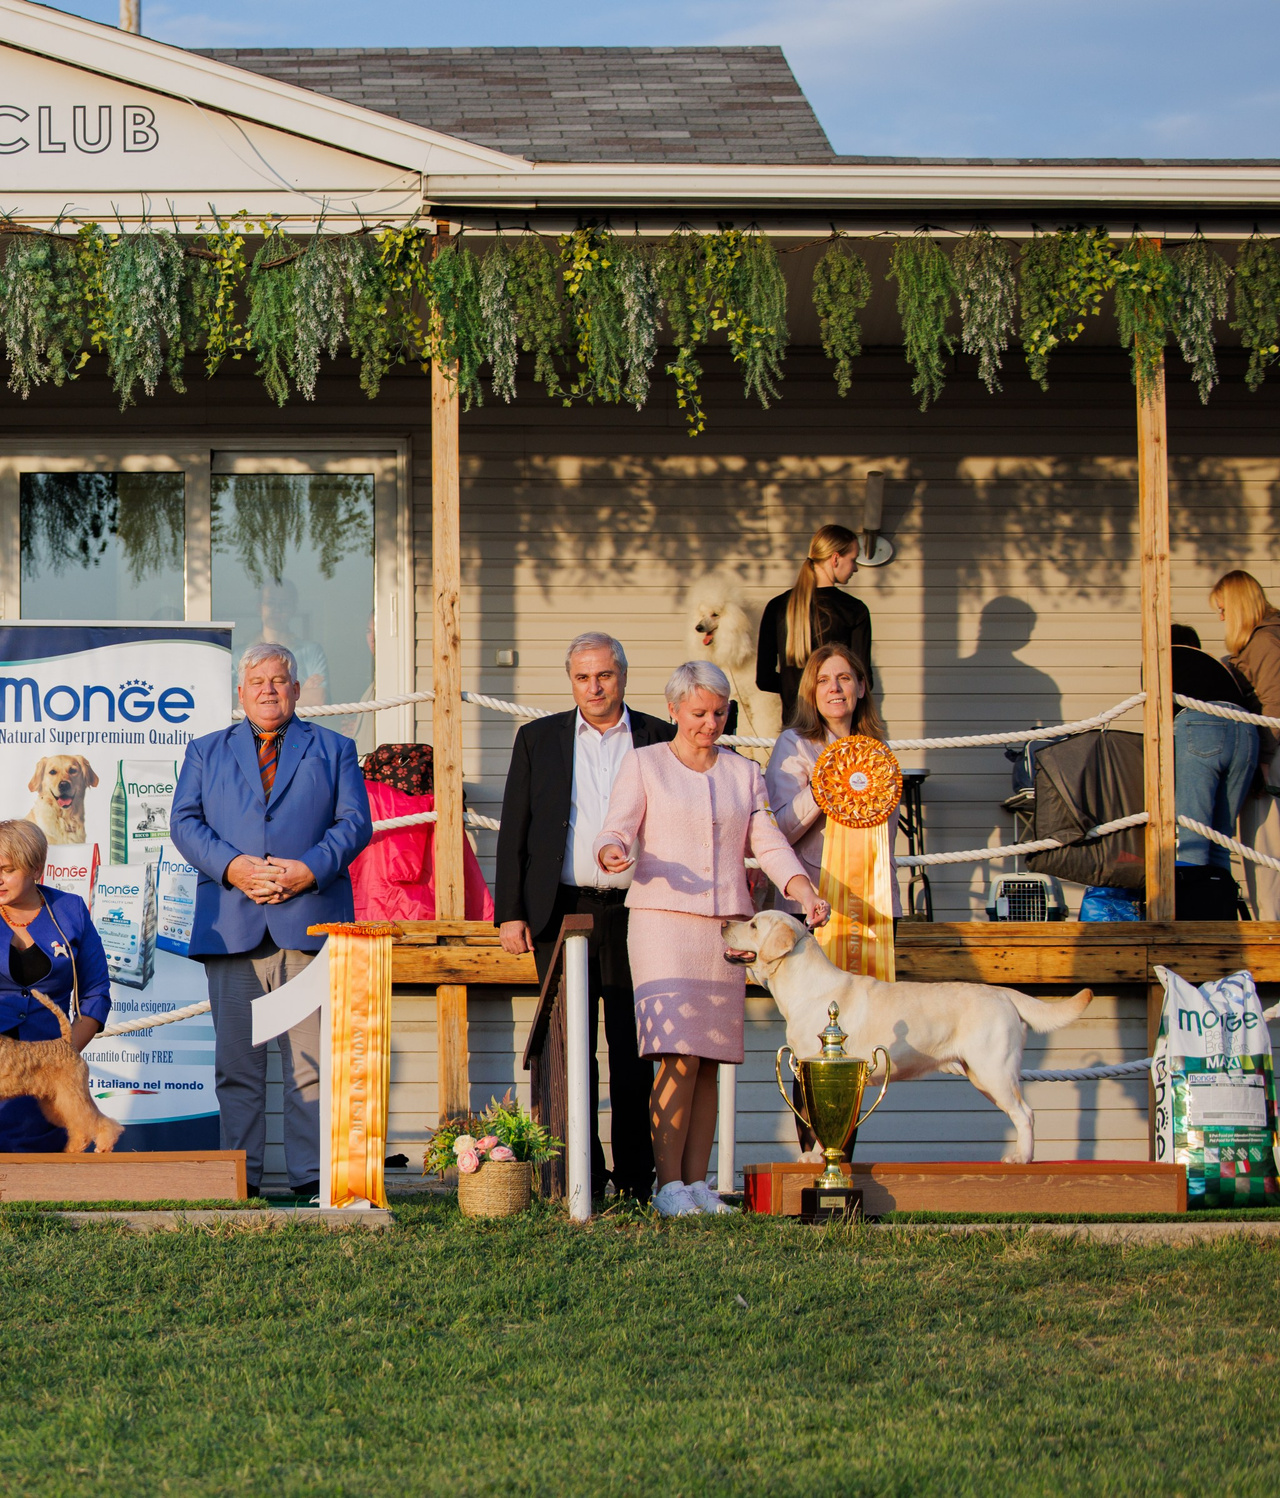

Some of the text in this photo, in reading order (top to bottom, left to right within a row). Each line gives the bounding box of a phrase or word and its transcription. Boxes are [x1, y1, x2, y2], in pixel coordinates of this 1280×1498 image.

[49, 728, 145, 746] Superpremium
[140, 999, 176, 1013] esigenza
[121, 1050, 150, 1065] Cruelty
[151, 1050, 174, 1063] FREE
[97, 1079, 140, 1089] italiano
[143, 1080, 161, 1089] nel
[164, 1080, 204, 1090] mondo
